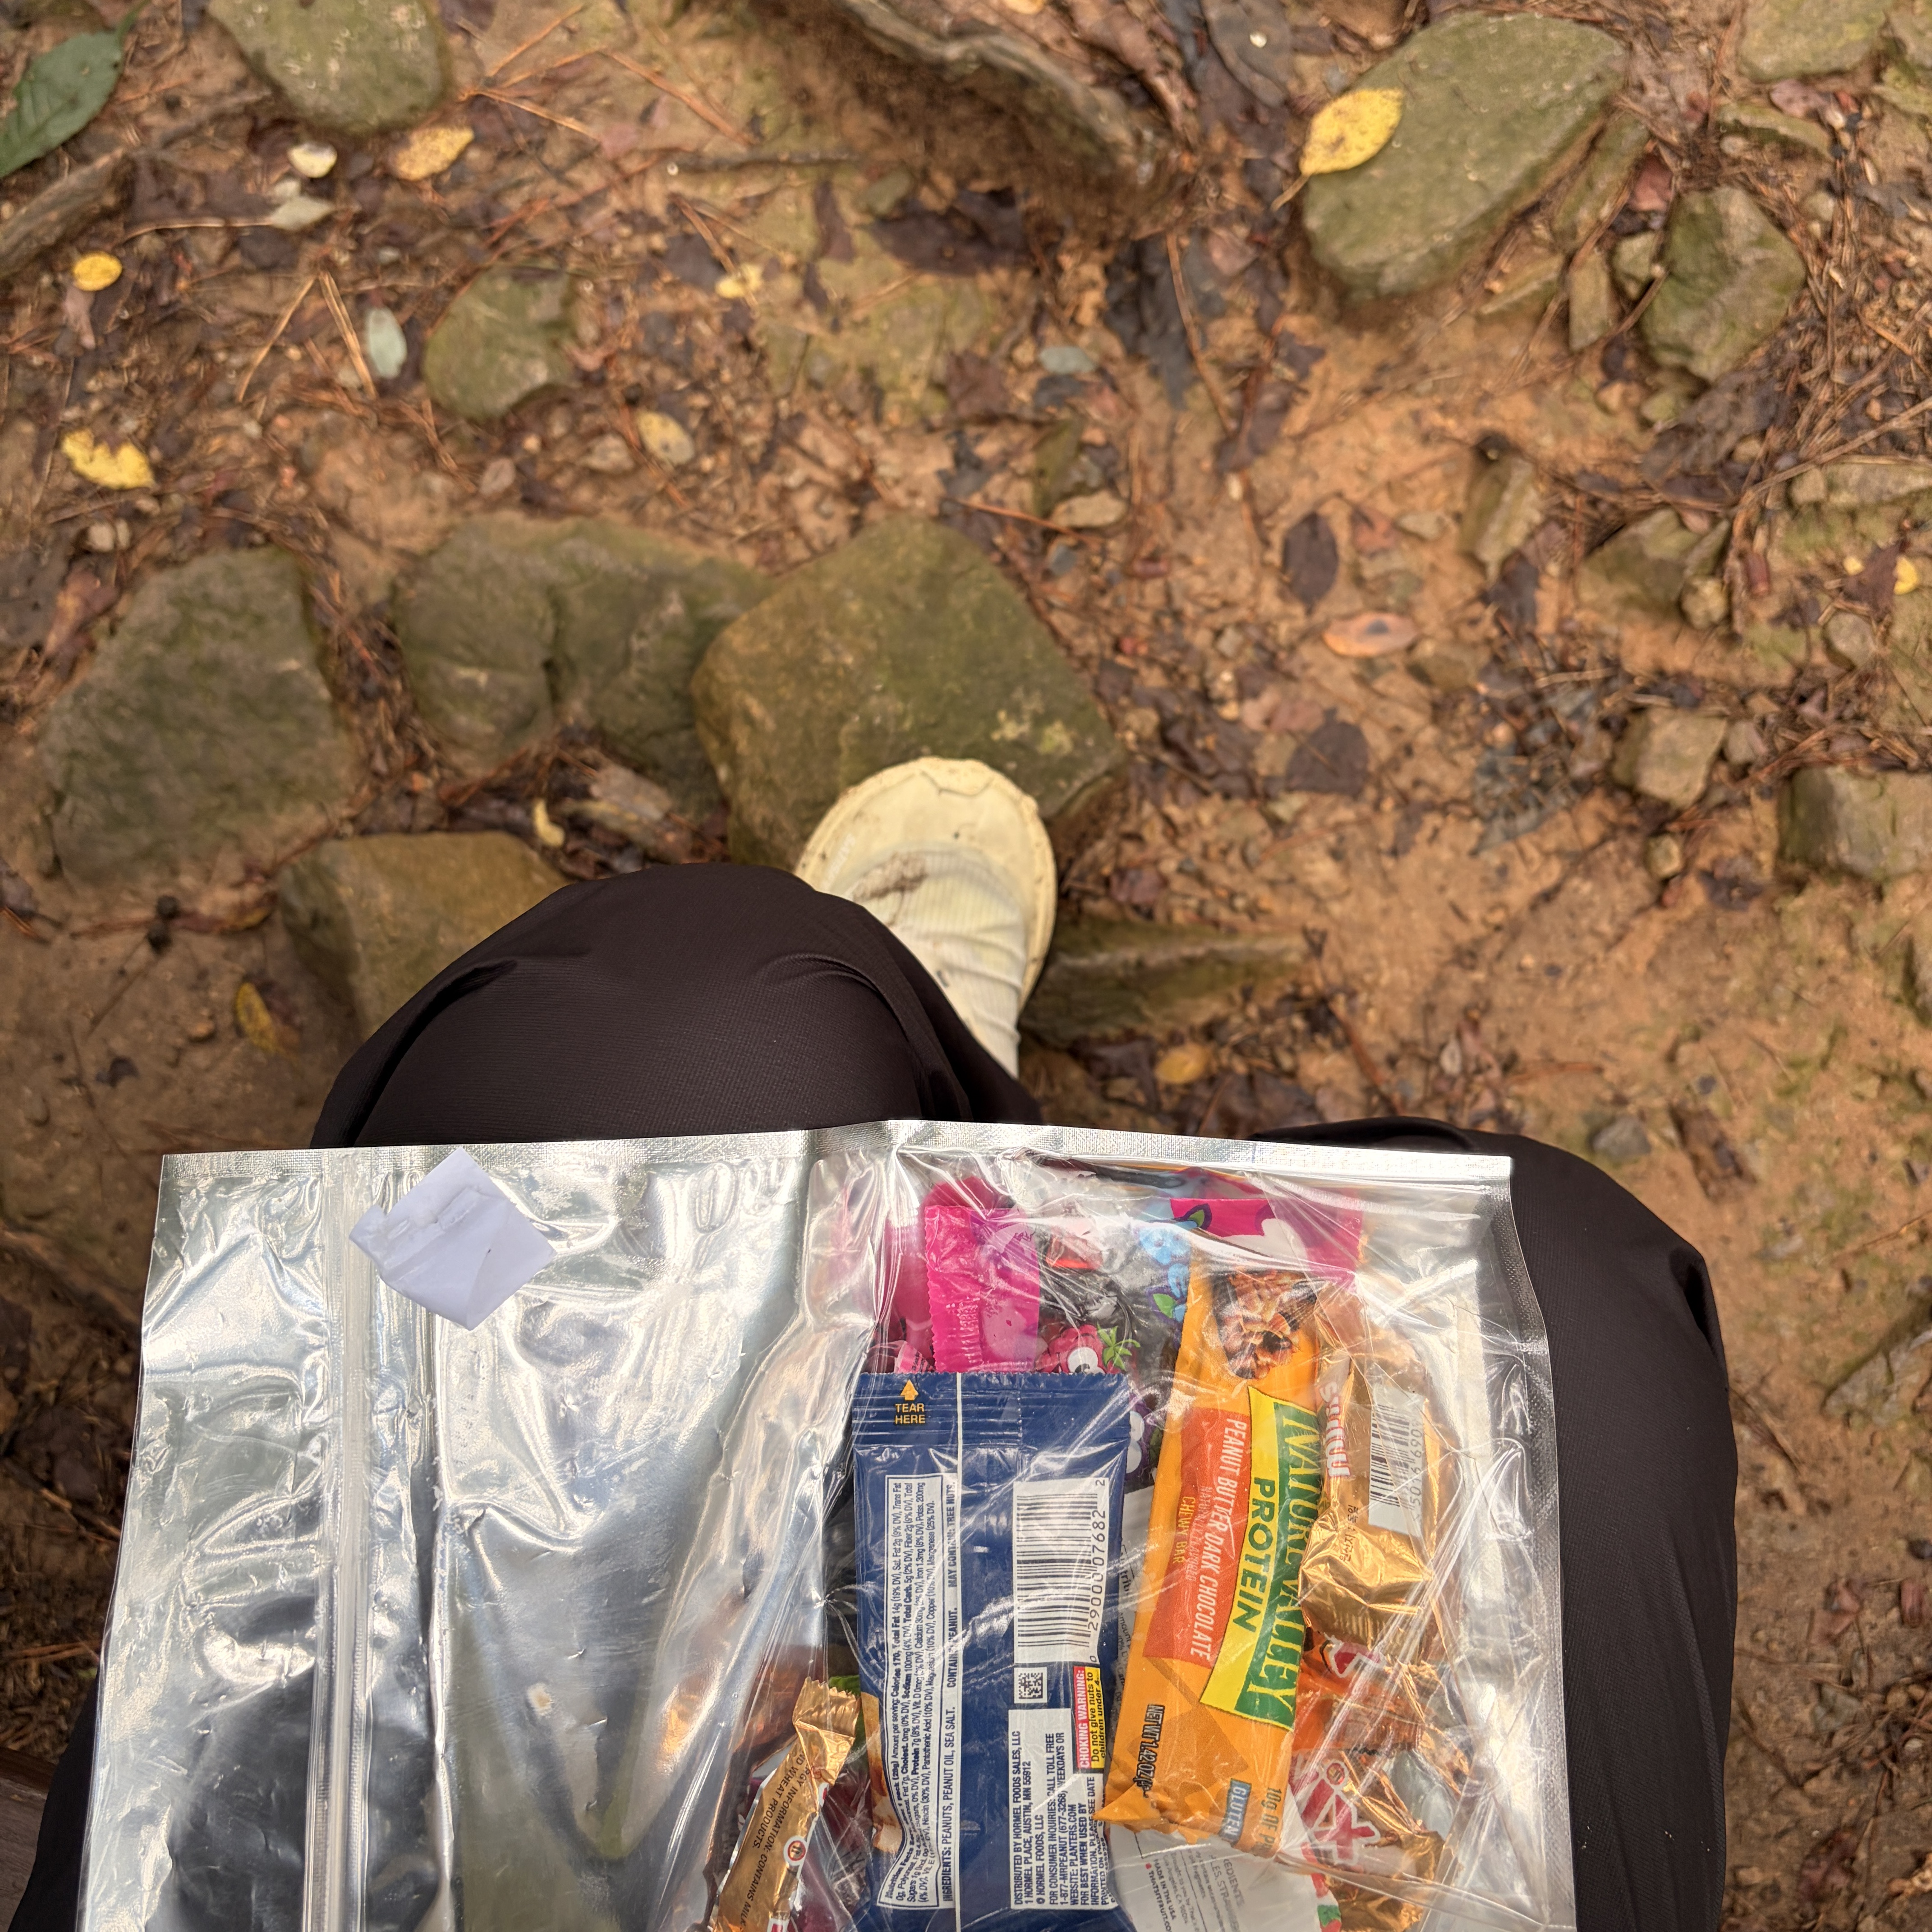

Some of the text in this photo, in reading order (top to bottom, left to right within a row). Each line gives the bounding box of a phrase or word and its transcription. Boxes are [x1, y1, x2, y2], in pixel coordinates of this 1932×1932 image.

[895, 1403, 924, 1412] TEAR
[895, 1415, 925, 1423] HERE
[892, 1494, 901, 1509] Trans
[916, 1483, 925, 1502] 200mg
[947, 1482, 955, 1504] NUTS.
[1091, 1510, 1105, 1566] 07682
[1173, 1496, 1196, 1564] CHEWY BAR
[1189, 1418, 1247, 1660] PEANUT BUTTER DARK CHOCOLATE
[892, 1548, 901, 1557] Fat
[916, 1549, 925, 1566] 1.3mg
[1233, 1477, 1275, 1633] PROTEIN
[948, 1569, 957, 1587] MAY
[892, 1603, 902, 1614] 14g
[1088, 1573, 1103, 1630] 29000
[903, 1605, 911, 1623] Total
[892, 1630, 900, 1648] Total
[904, 1652, 913, 1672] 100mg
[891, 1669, 901, 1697] Calories
[903, 1674, 911, 1698] Sodium
[923, 1719, 931, 1732] Acid
[1076, 1670, 1090, 1768] CHOKING WARNING:
[1086, 1672, 1100, 1762] Do not give nuts to
[1147, 1706, 1163, 1723] NET
[892, 1724, 902, 1733] per
[902, 1728, 910, 1742] 0mg
[1056, 1733, 1064, 1743] OR
[1143, 1726, 1160, 1741] WT
[922, 1733, 932, 1769] Pantothenic
[1046, 1734, 1054, 1753] FREE
[1140, 1743, 1157, 1762] 1.42
[911, 1748, 920, 1775] Protein
[1046, 1756, 1055, 1775] TOLL
[1138, 1764, 1154, 1777] OZ
[776, 1766, 799, 1798] WHEAT
[1023, 1761, 1031, 1785] 55912
[1023, 1788, 1031, 1800] MN
[1047, 1777, 1055, 1796] CALL
[942, 1707, 956, 1901] INGREDIENTS: PEANUTS, PEANUT OIL, SEA SALT.
[1078, 1803, 1086, 1814] BY
[1261, 1788, 1282, 1810] 10g
[1012, 1731, 1023, 1905] DISTRIBUTED BY HORMEL FOODS SALES, LLC
[1023, 1803, 1033, 1834] AUSTIN,
[1048, 1799, 1057, 1841] INQUIRIES:
[1225, 1787, 1247, 1835] GLUTEN
[752, 1799, 777, 1849] PRODUCTS.
[1035, 1815, 1043, 1830] LLC
[1261, 1814, 1279, 1831] OF
[740, 1764, 810, 1926] RGY INFORMATION: CONTAINS MILK
[1024, 1835, 1033, 1864] PLACE,
[1035, 1832, 1045, 1861] FOODS,
[1068, 1804, 1079, 1905] WEBSITE: PLANTERS.COM
[1079, 1841, 1087, 1865] WHEN
[1049, 1844, 1057, 1888] CONSUMER
[1059, 1836, 1068, 1905] 1-877-MRPEANUT
[1098, 1857, 1104, 1868] ON
[1024, 1867, 1032, 1898] HORMEL
[1036, 1864, 1044, 1895] HORMEL
[1080, 1868, 1088, 1888] BEST
[1090, 1849, 1099, 1905] INFORMATION,
[1099, 1871, 1109, 1904] PRINTED
[1081, 1891, 1089, 1905] FOR
